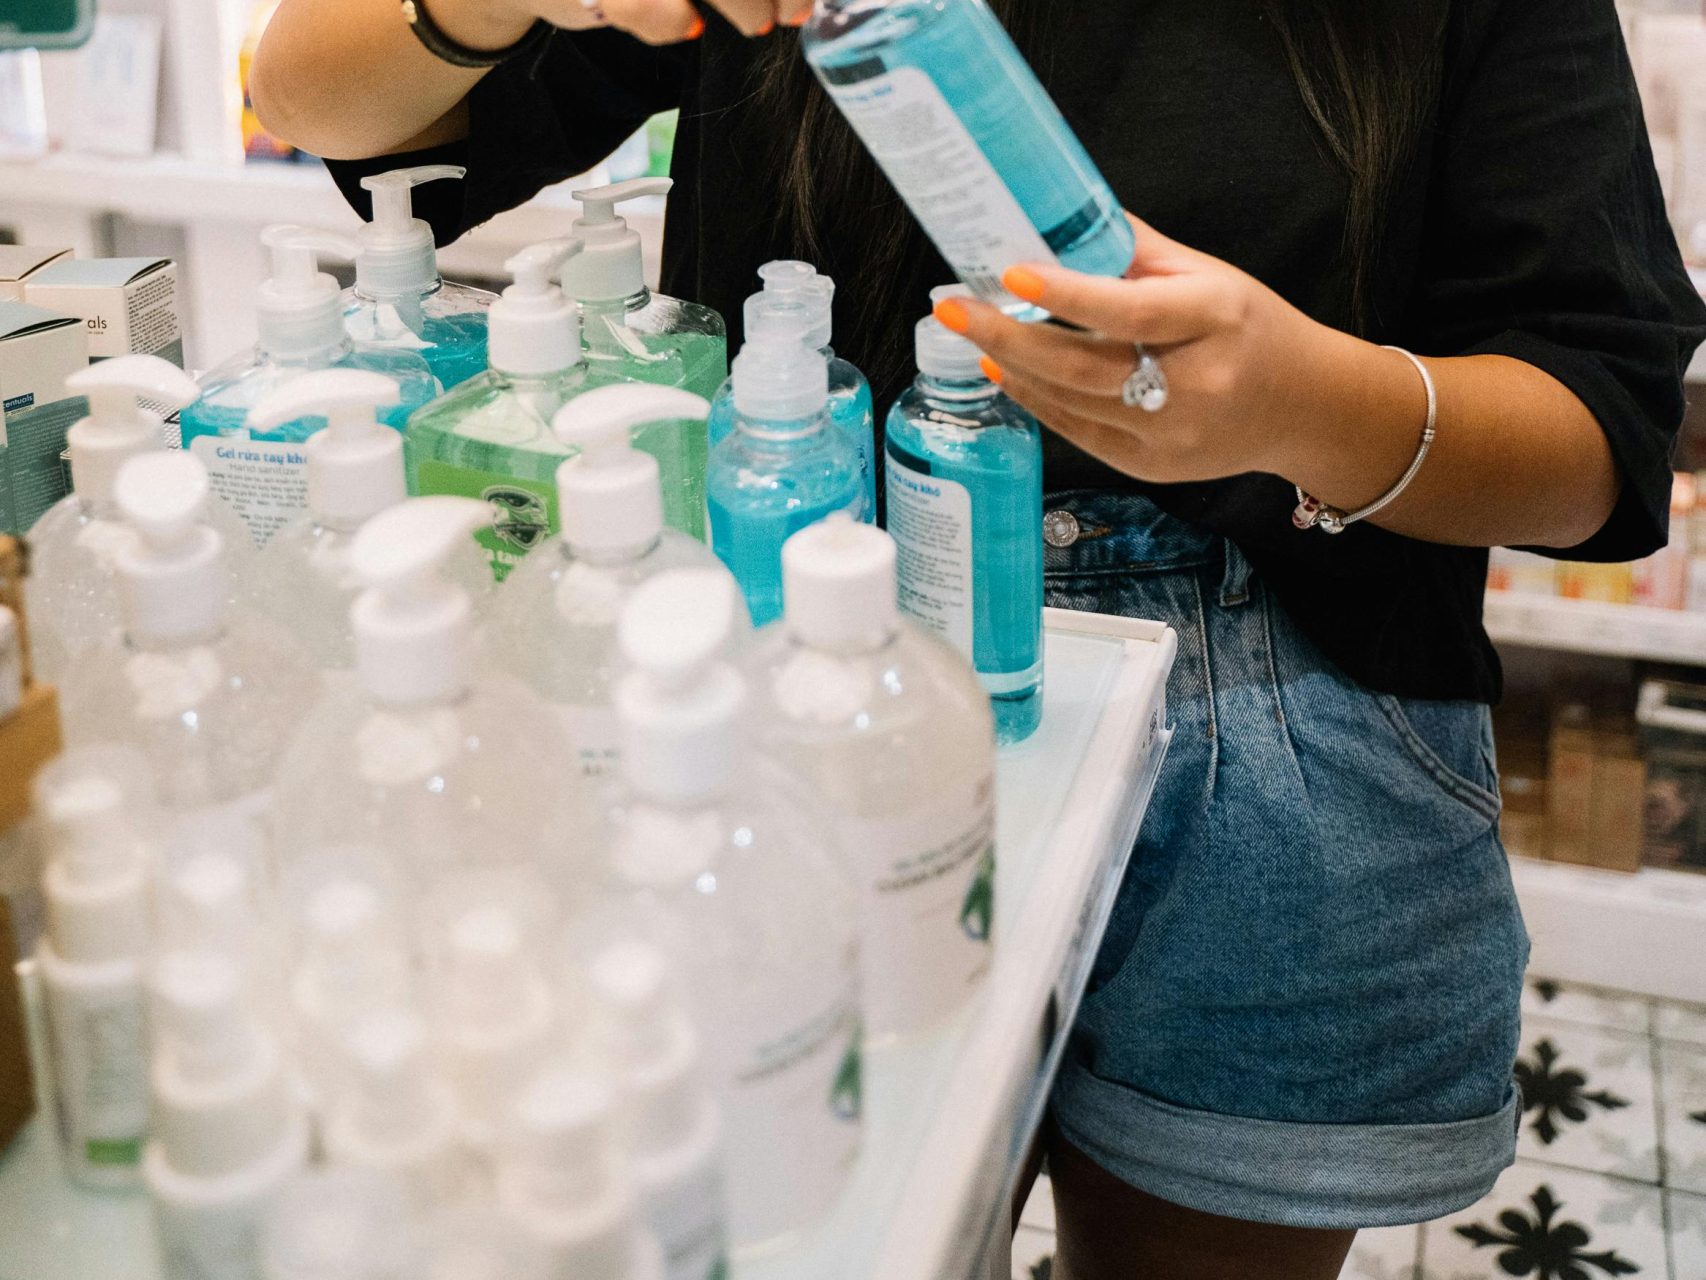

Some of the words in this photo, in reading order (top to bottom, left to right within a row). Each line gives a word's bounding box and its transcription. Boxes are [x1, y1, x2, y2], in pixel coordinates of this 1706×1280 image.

[88, 315, 107, 329] als
[216, 447, 235, 459] Gel
[264, 453, 284, 465] tay
